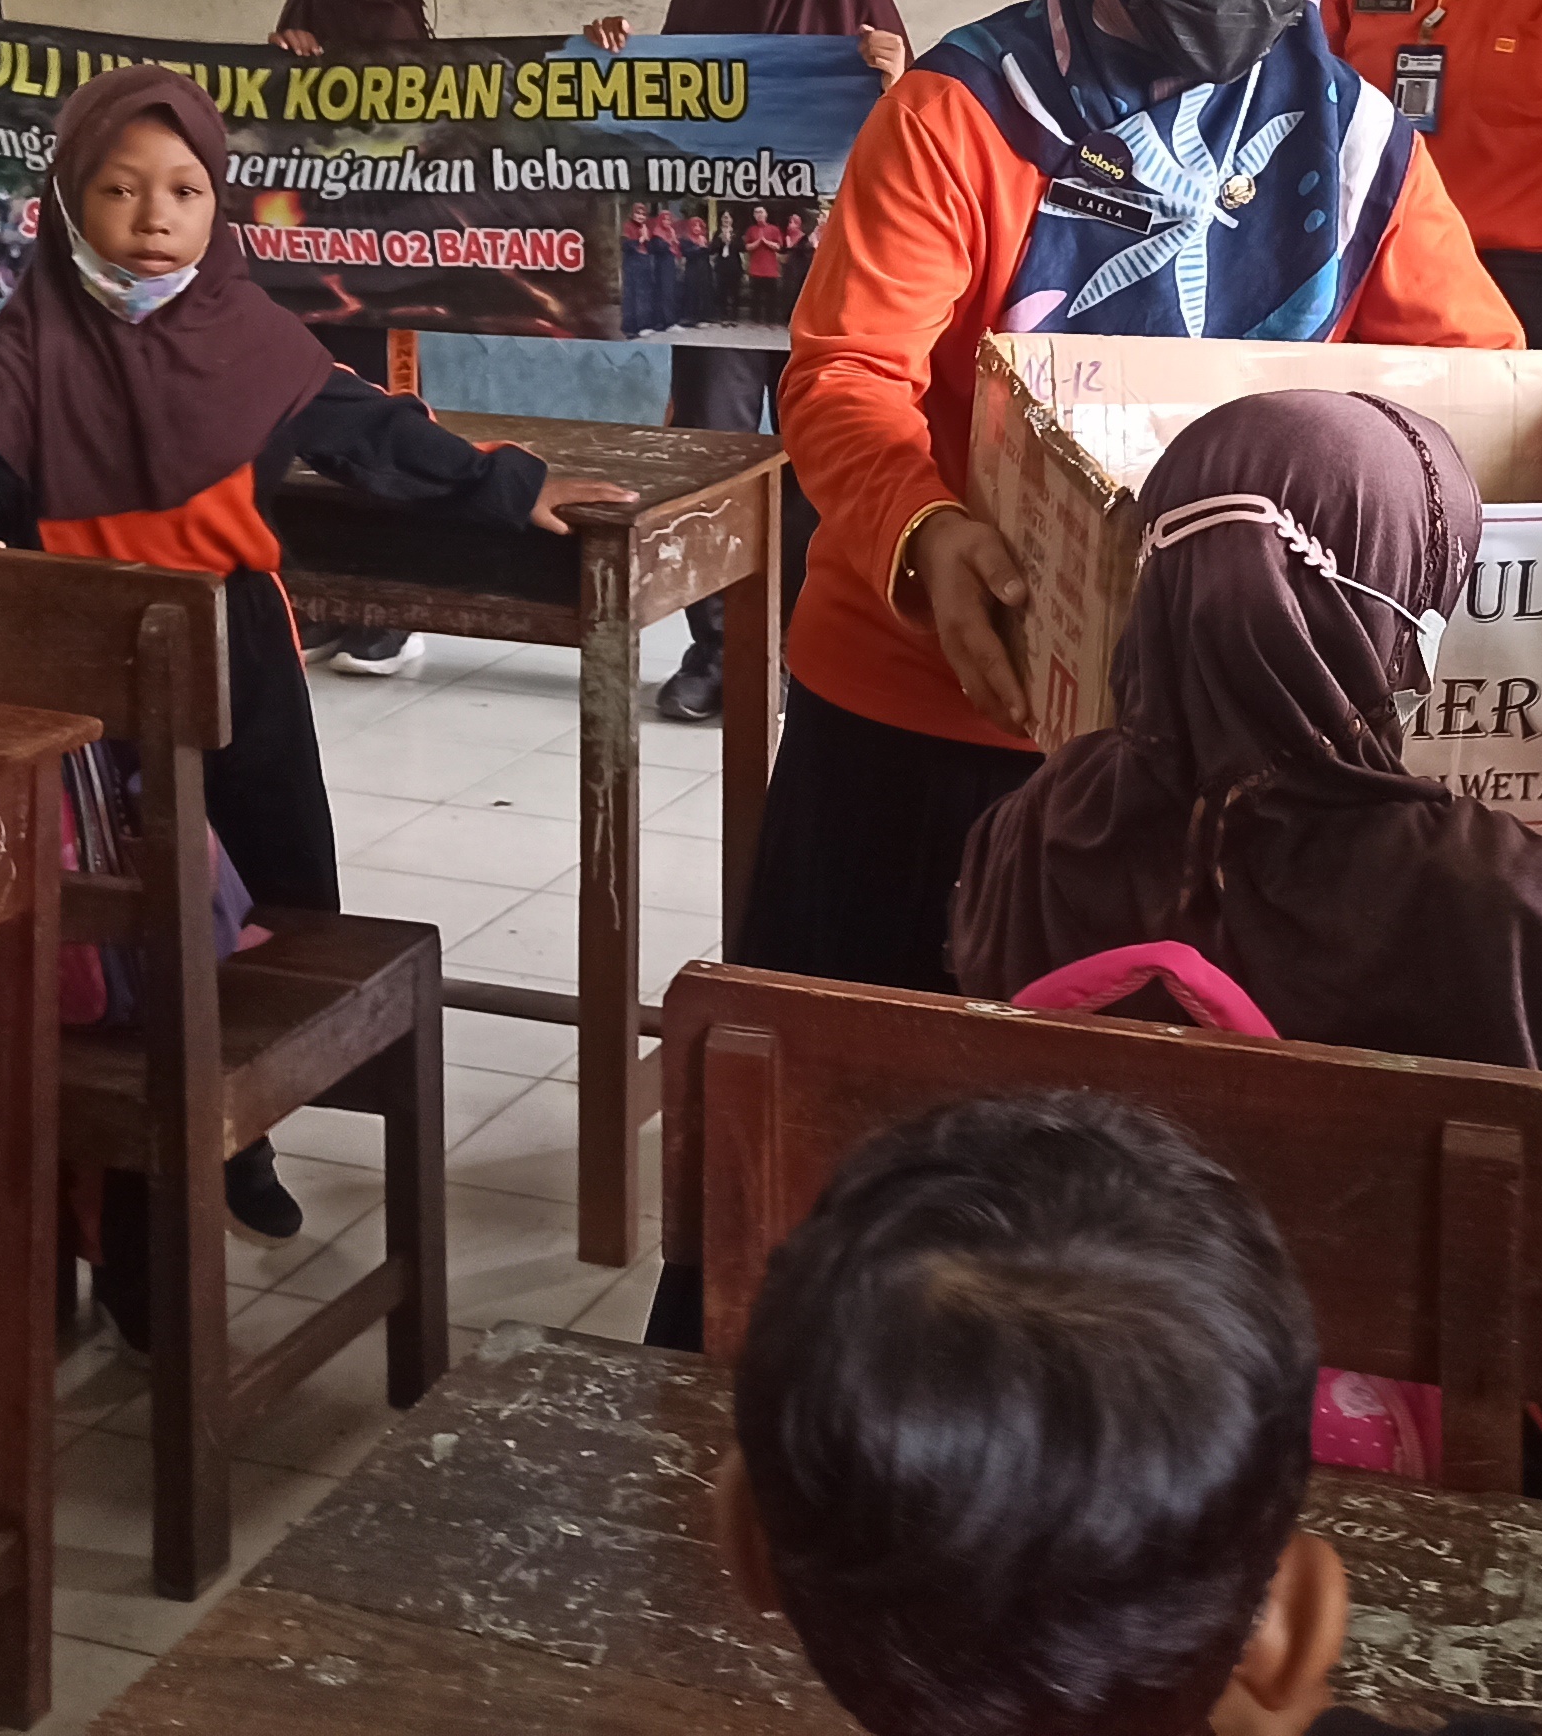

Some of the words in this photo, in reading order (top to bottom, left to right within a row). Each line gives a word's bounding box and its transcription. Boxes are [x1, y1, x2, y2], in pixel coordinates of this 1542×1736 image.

[283, 63, 503, 121] KORBAN
[512, 60, 746, 121] SEMERU
[493, 148, 630, 192] beban
[648, 150, 815, 199] mereka
[1077, 197, 1123, 219] LAELA
[243, 224, 382, 265] WETAN
[382, 228, 432, 267] 02
[434, 227, 585, 272] BATANG
